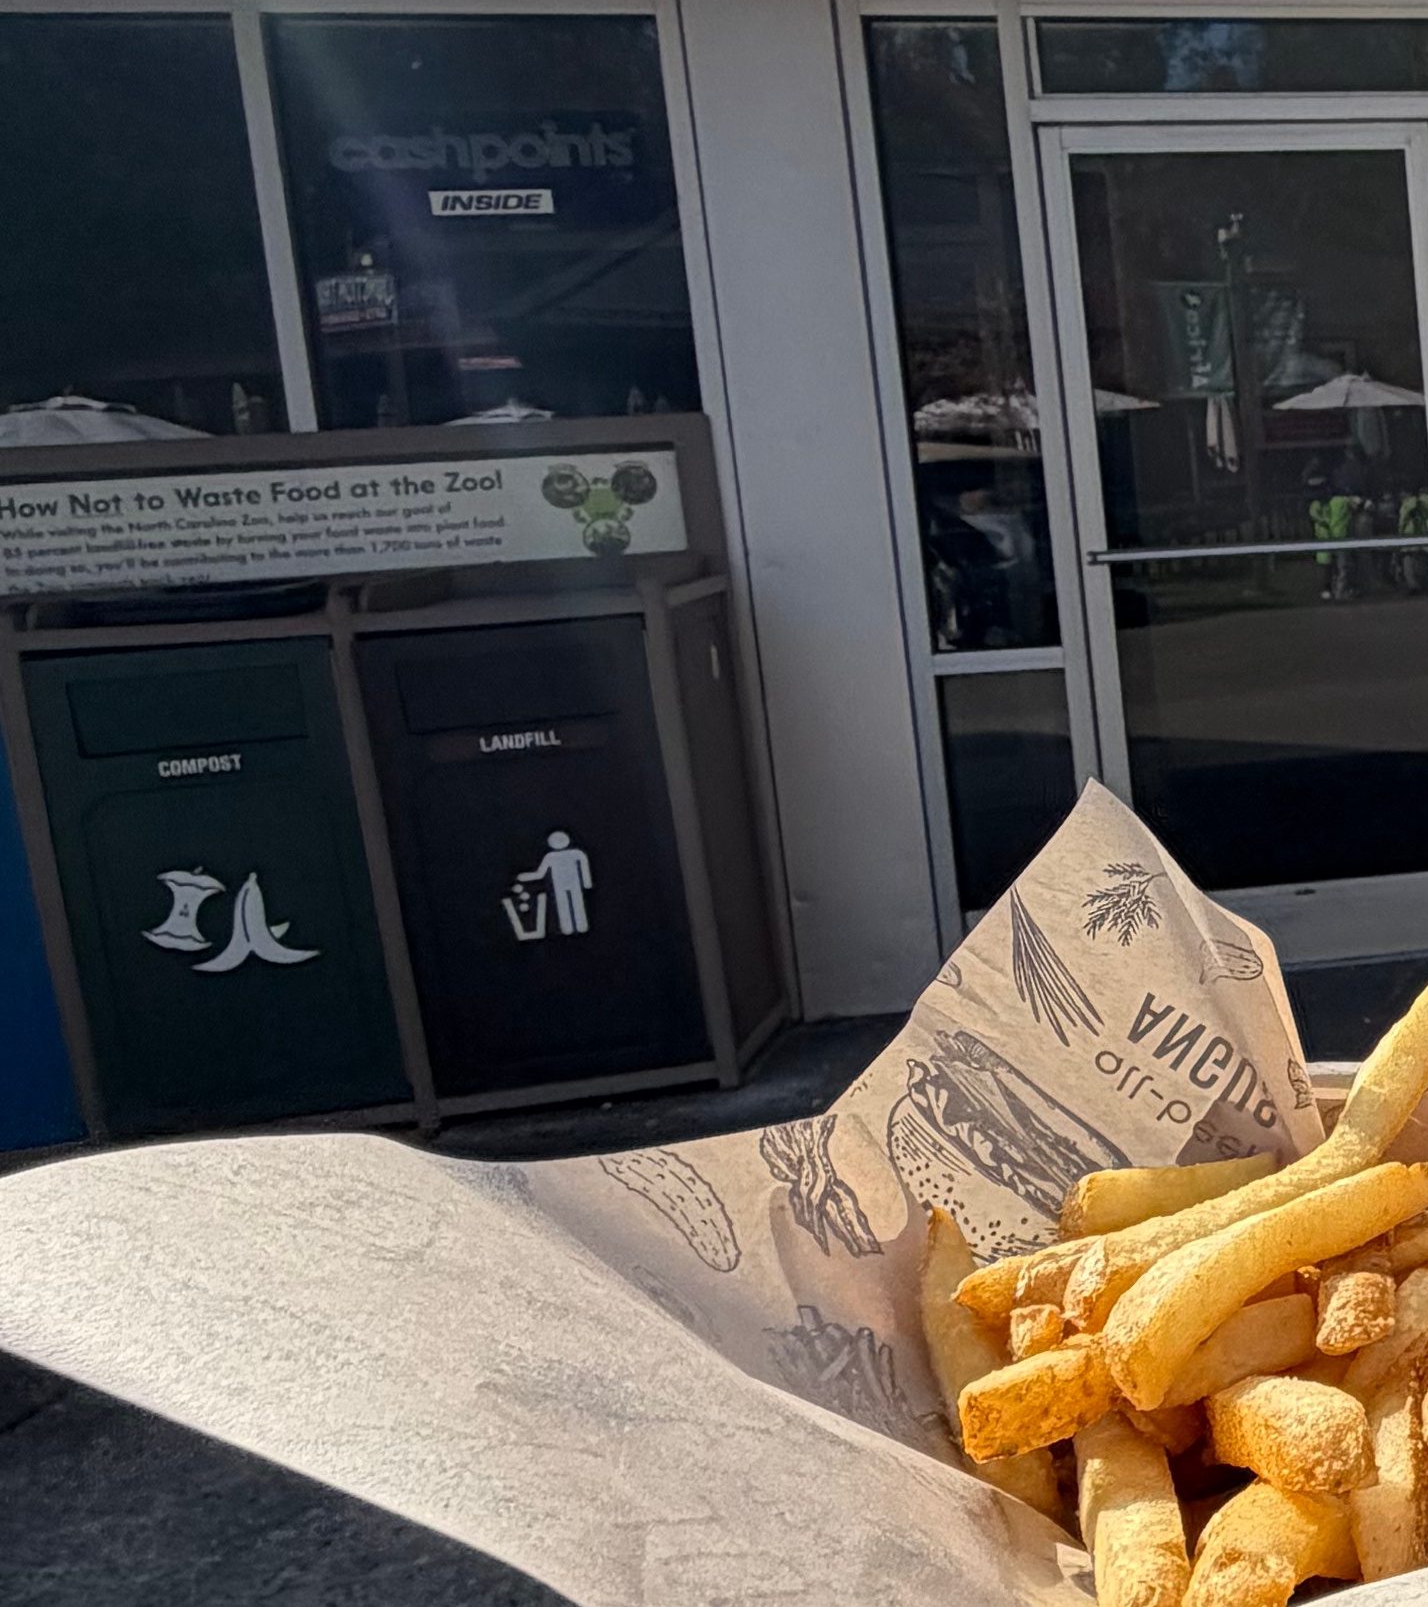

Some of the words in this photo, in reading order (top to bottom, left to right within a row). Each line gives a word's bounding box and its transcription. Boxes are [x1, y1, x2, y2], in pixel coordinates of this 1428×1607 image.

[328, 122, 636, 182] cashpoints
[439, 193, 543, 213] INSIDE
[0, 497, 58, 520] How
[68, 493, 123, 515] Not
[134, 492, 165, 511] to
[174, 486, 262, 508] Waste
[270, 480, 341, 503] Food
[350, 479, 380, 499] at
[389, 475, 435, 496] the
[443, 469, 504, 493] Zoo!
[101, 523, 124, 534] the
[128, 521, 171, 533] North
[176, 516, 237, 530] Carolina
[278, 512, 309, 525] help
[332, 508, 372, 521] reach
[402, 504, 434, 519] goal
[438, 501, 451, 514] of
[215, 535, 233, 547] by
[326, 525, 359, 538] food
[268, 547, 291, 560] the
[334, 544, 366, 556] than
[446, 536, 461, 549] of
[479, 728, 562, 753] LANDFILL
[157, 753, 243, 778] COMPOST
